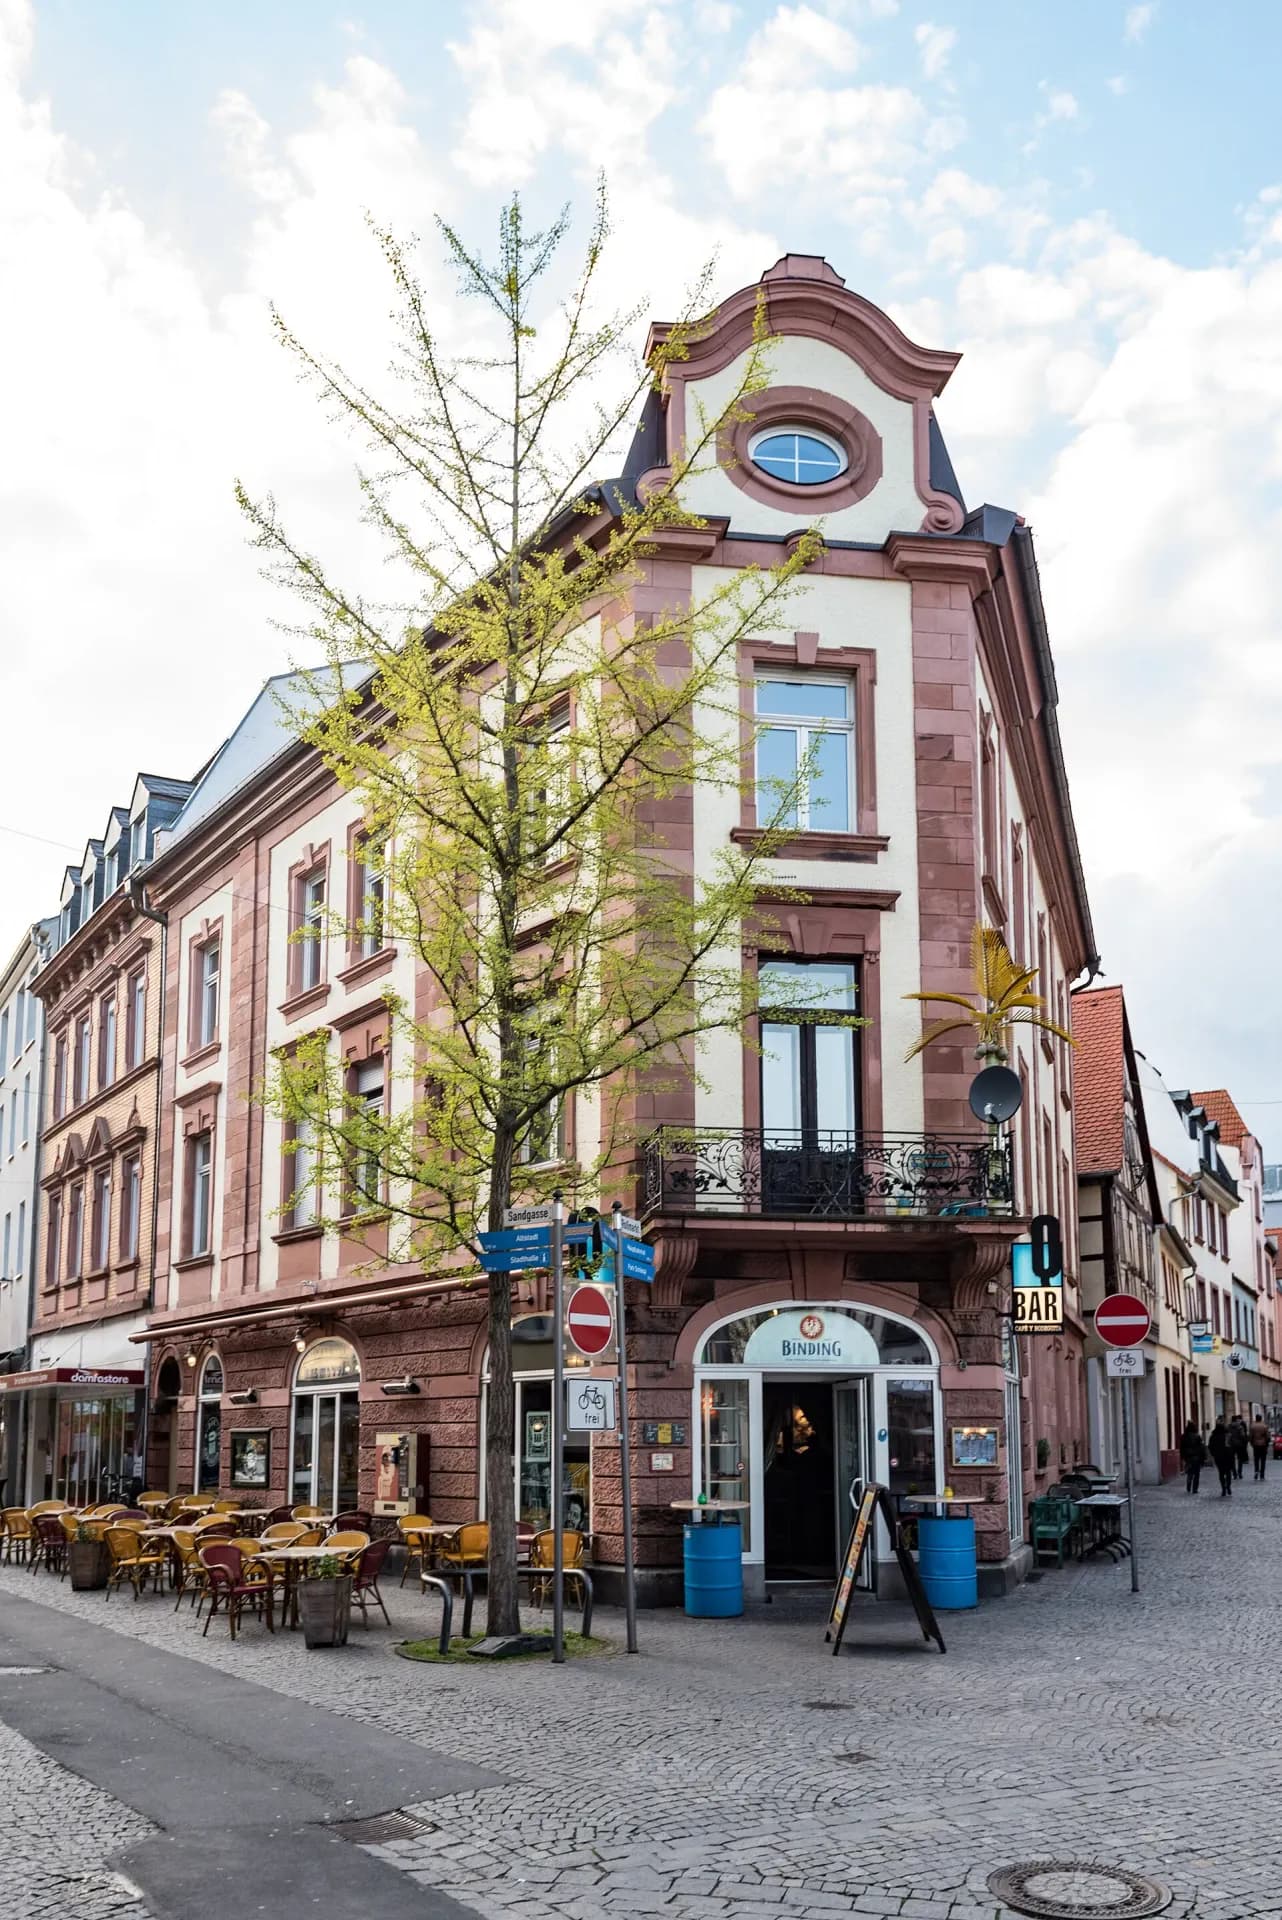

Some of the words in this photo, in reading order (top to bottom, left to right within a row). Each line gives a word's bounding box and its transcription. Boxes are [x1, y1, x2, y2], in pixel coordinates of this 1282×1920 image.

[508, 1209, 549, 1222] Sandgasse
[1013, 1291, 1058, 1321] BAR
[782, 1339, 841, 1357] BINDING
[584, 1412, 600, 1424] frei
